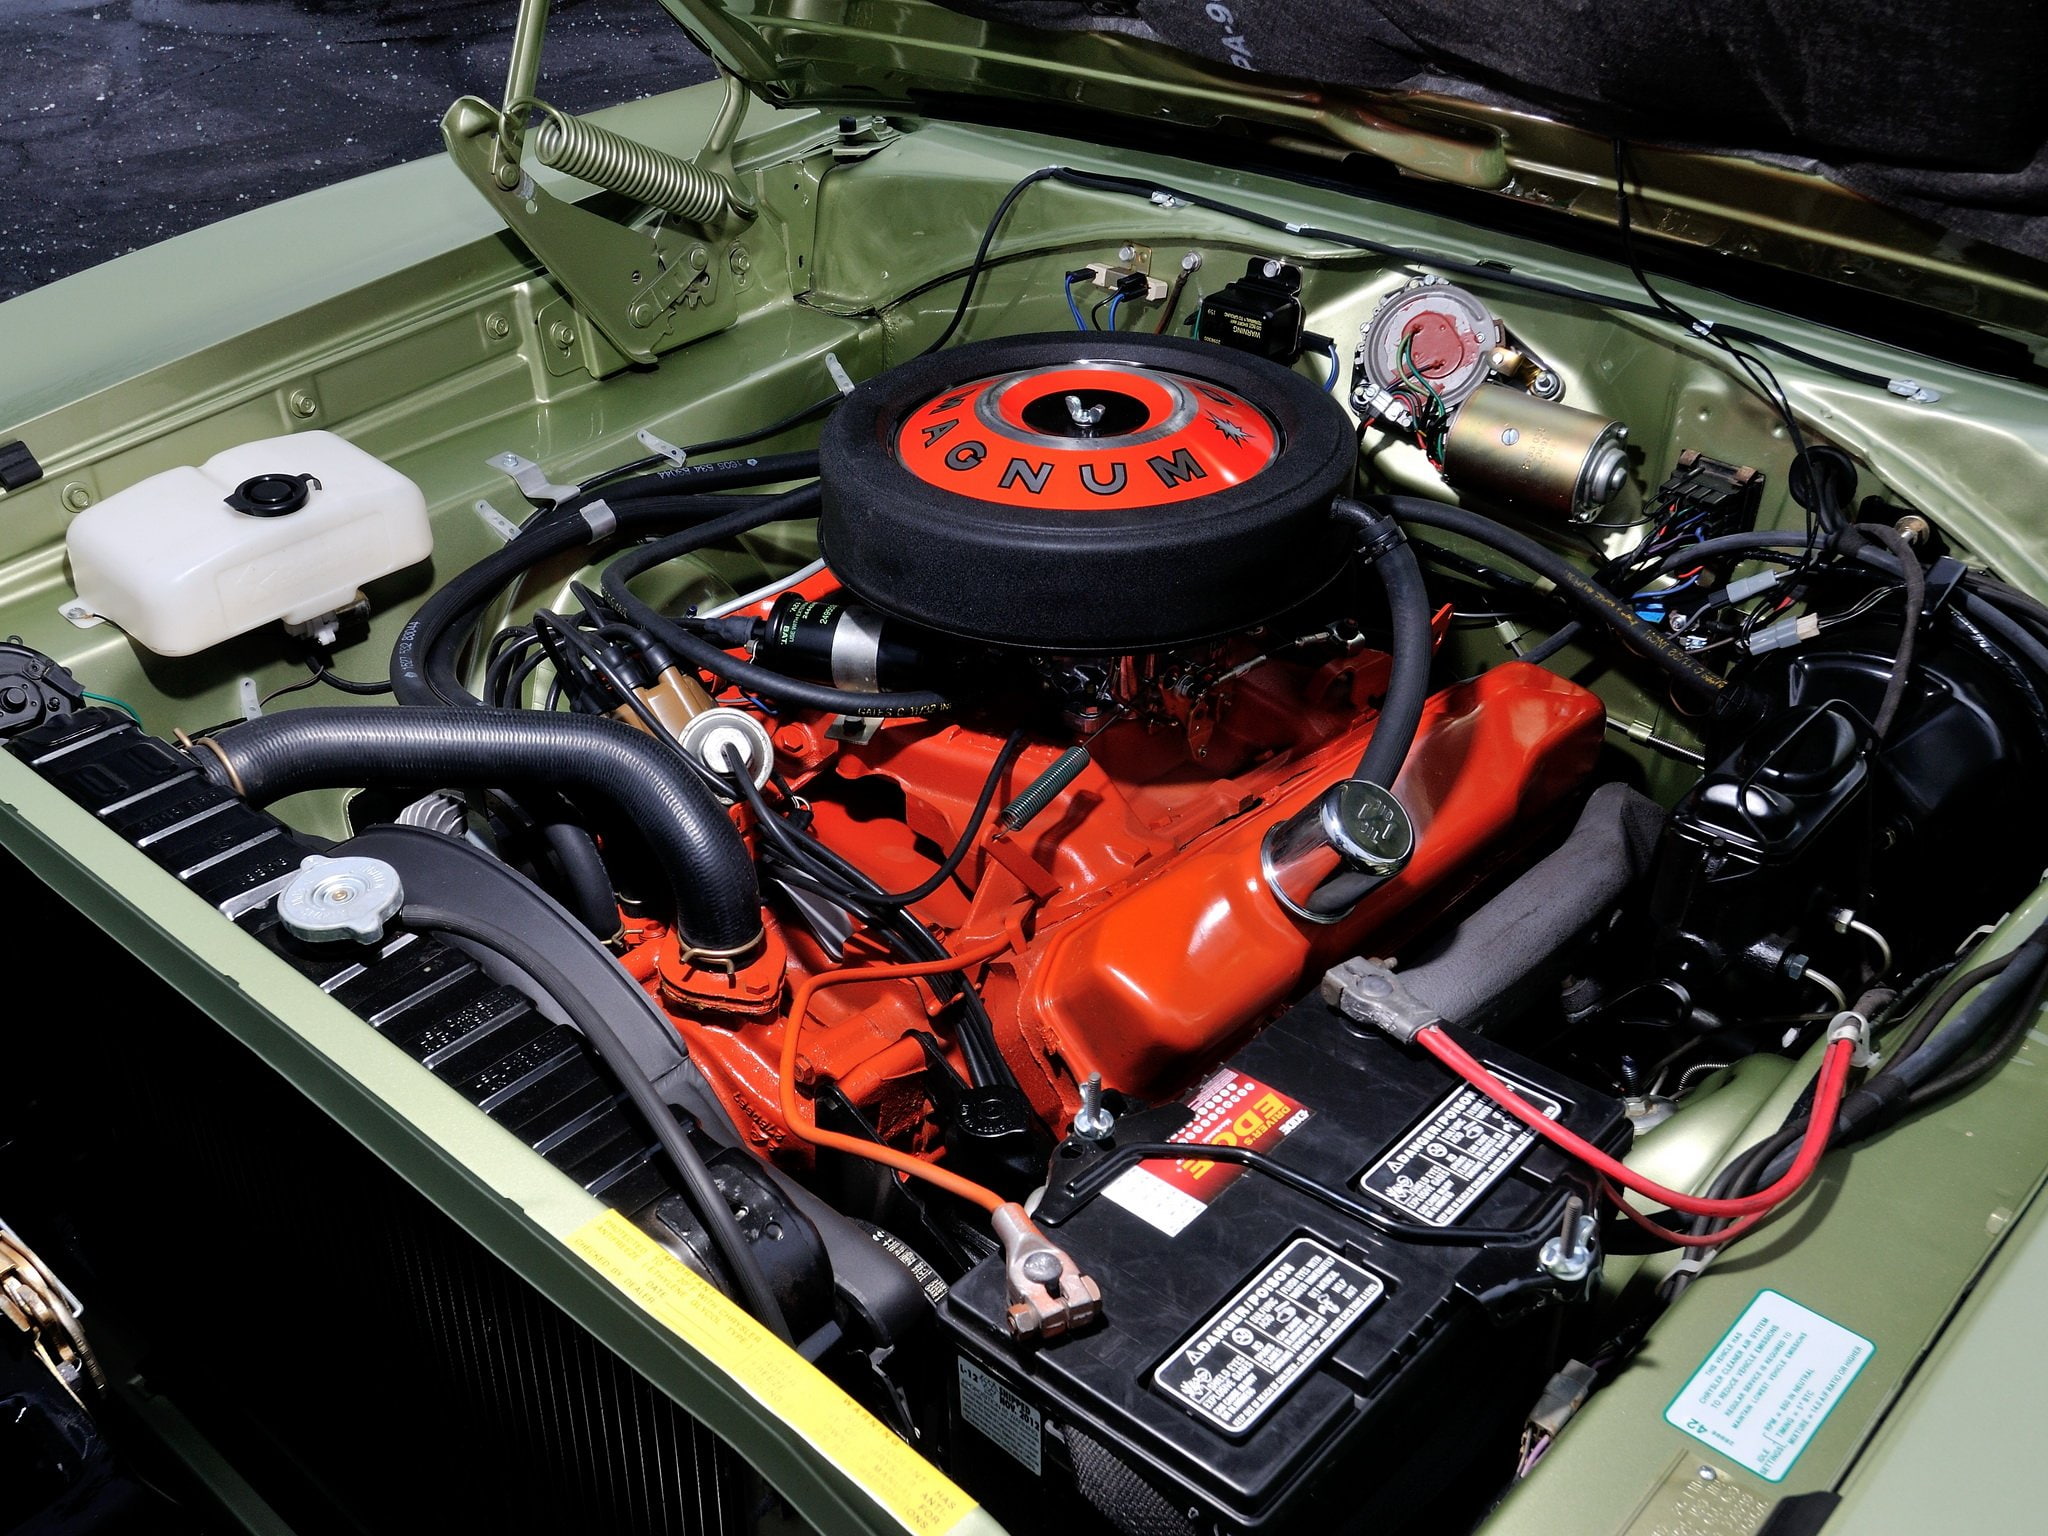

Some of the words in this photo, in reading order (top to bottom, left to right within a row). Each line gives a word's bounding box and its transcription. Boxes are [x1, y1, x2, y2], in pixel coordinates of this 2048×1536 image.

[1232, 325, 1261, 339] WARNING
[928, 387, 1207, 497] MAGNUM
[1243, 1105, 1292, 1147] DRIVER'S
[1395, 1089, 1478, 1164] DANGER/POISON
[574, 1237, 610, 1267] CHECKED
[610, 1267, 623, 1277] BY
[623, 1277, 655, 1304] DEALER
[645, 1280, 667, 1298] DATE
[659, 1252, 716, 1296] IMPORTANT
[717, 1308, 762, 1343] CHRYSLER
[1196, 1262, 1295, 1354] DANGER/POISON
[1699, 1375, 1724, 1404] CHRYSLER
[1721, 1350, 1743, 1375] CLEANER
[1741, 1339, 1752, 1349] AIR
[1749, 1317, 1769, 1338] SYSTEM
[1711, 1400, 1721, 1408] TO
[1718, 1377, 1738, 1399] REDUCE
[1736, 1354, 1756, 1376] VEHICLE
[1753, 1324, 1778, 1353] EMISSIONS
[1714, 1344, 1733, 1363] VEHICLE
[1730, 1331, 1742, 1343] HAS
[1725, 1393, 1745, 1416] REGULAR
[1743, 1371, 1762, 1392] SERVICE
[1764, 1339, 1785, 1364] REQUIRED
[1782, 1331, 1792, 1339] TO
[1732, 1404, 1753, 1429] MAINTAIN
[1751, 1382, 1770, 1403] LOWEST
[1768, 1360, 1786, 1380] VEHICLE
[1784, 1332, 1807, 1358] EMISSIONS
[1788, 1419, 1809, 1444] MIXTURE
[1843, 1345, 1862, 1366] HIGHER
[1792, 1367, 1814, 1392] NEUTRAL
[998, 1385, 1030, 1415] SHIPPED
[999, 1395, 1016, 1415] NOV.
[1018, 1409, 1039, 1431] 2012
[841, 1398, 901, 1446] WARNING
[1686, 1417, 1708, 1435] 42
[1776, 1417, 1794, 1437] TIMING
[1756, 1448, 1770, 1462] IDLE
